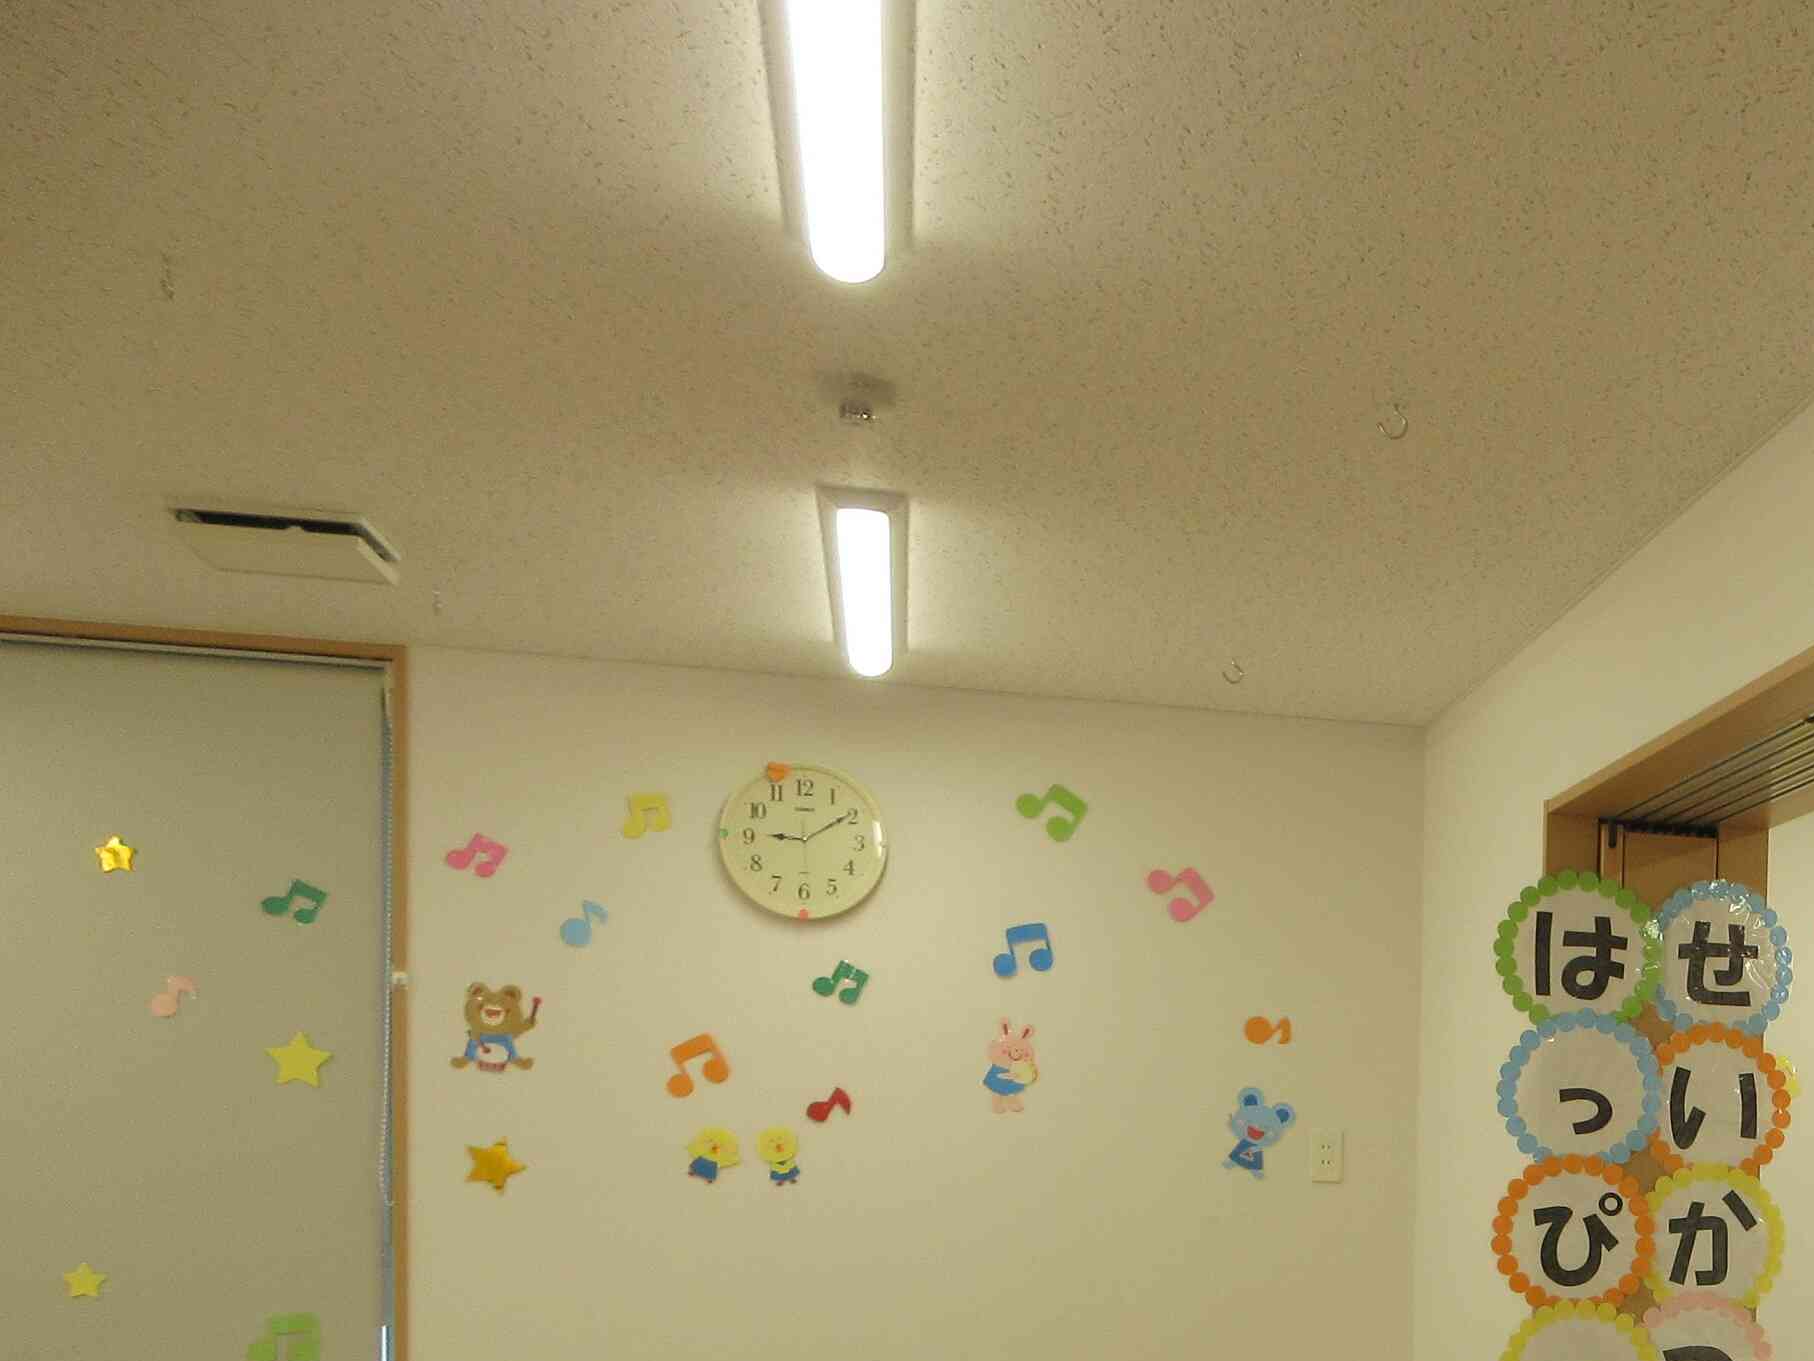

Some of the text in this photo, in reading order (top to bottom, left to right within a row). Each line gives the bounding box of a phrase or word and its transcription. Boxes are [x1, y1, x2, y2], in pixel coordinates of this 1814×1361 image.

[770, 785, 783, 802] 11
[795, 779, 814, 797] 12
[750, 802, 767, 819] 10
[847, 808, 859, 825] 2
[743, 827, 755, 845] 9
[854, 835, 865, 851] 3
[750, 854, 763, 872] 8
[843, 859, 855, 876] 4
[771, 876, 782, 892] 7
[798, 884, 810, 900] 6
[826, 878, 838, 896] 5
